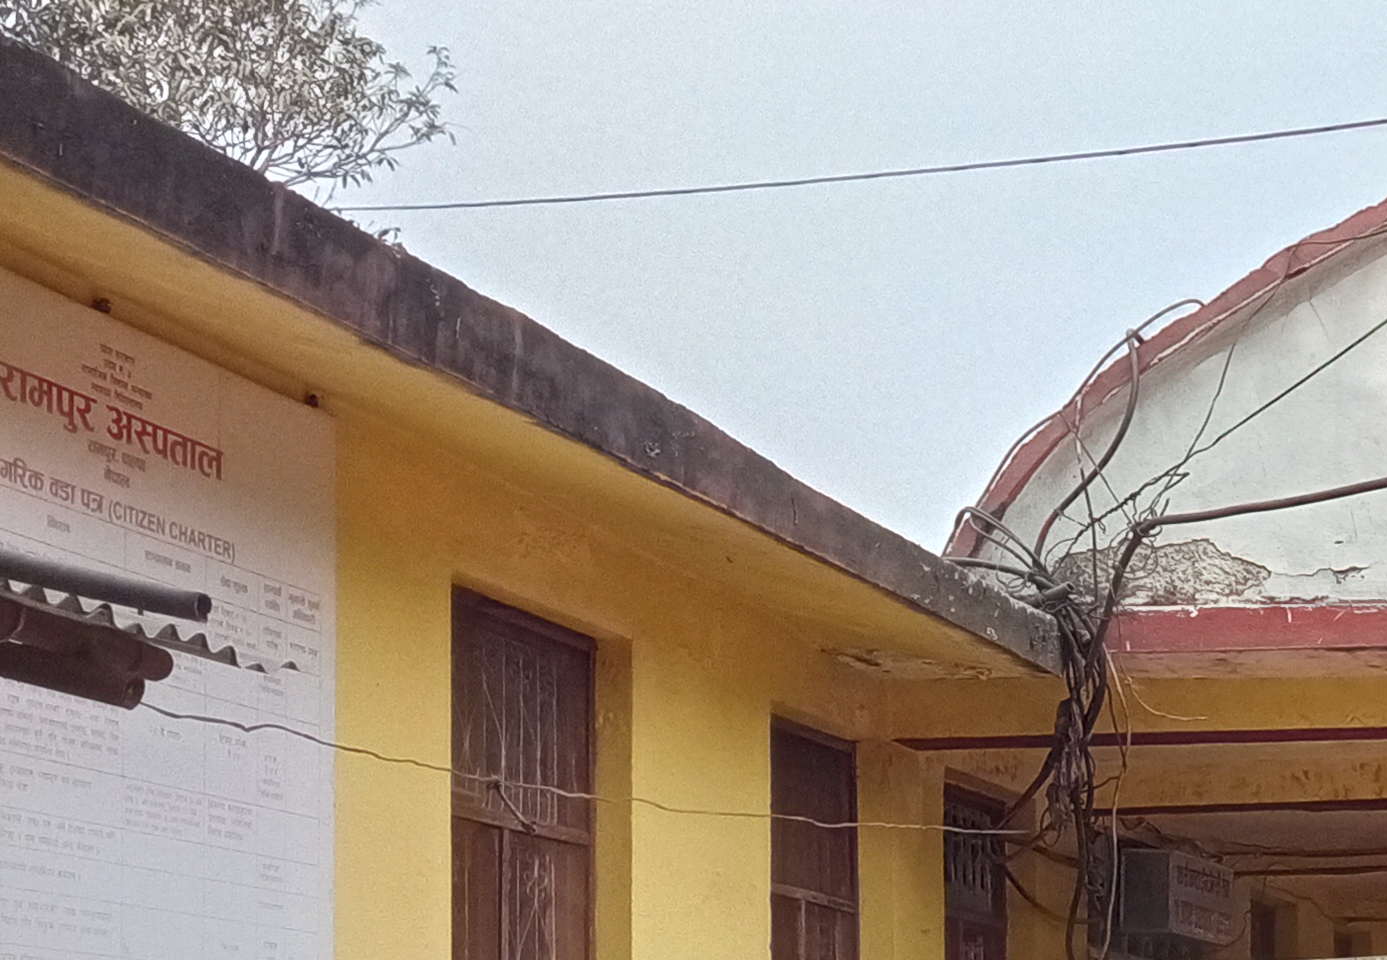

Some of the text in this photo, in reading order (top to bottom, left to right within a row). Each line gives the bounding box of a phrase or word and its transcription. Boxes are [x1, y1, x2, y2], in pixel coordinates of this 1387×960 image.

[106, 404, 224, 481] अस्पताल
[0, 457, 45, 490] गरिक
[107, 499, 166, 538] (CITIZEN
[168, 520, 236, 565] CHARTER)
